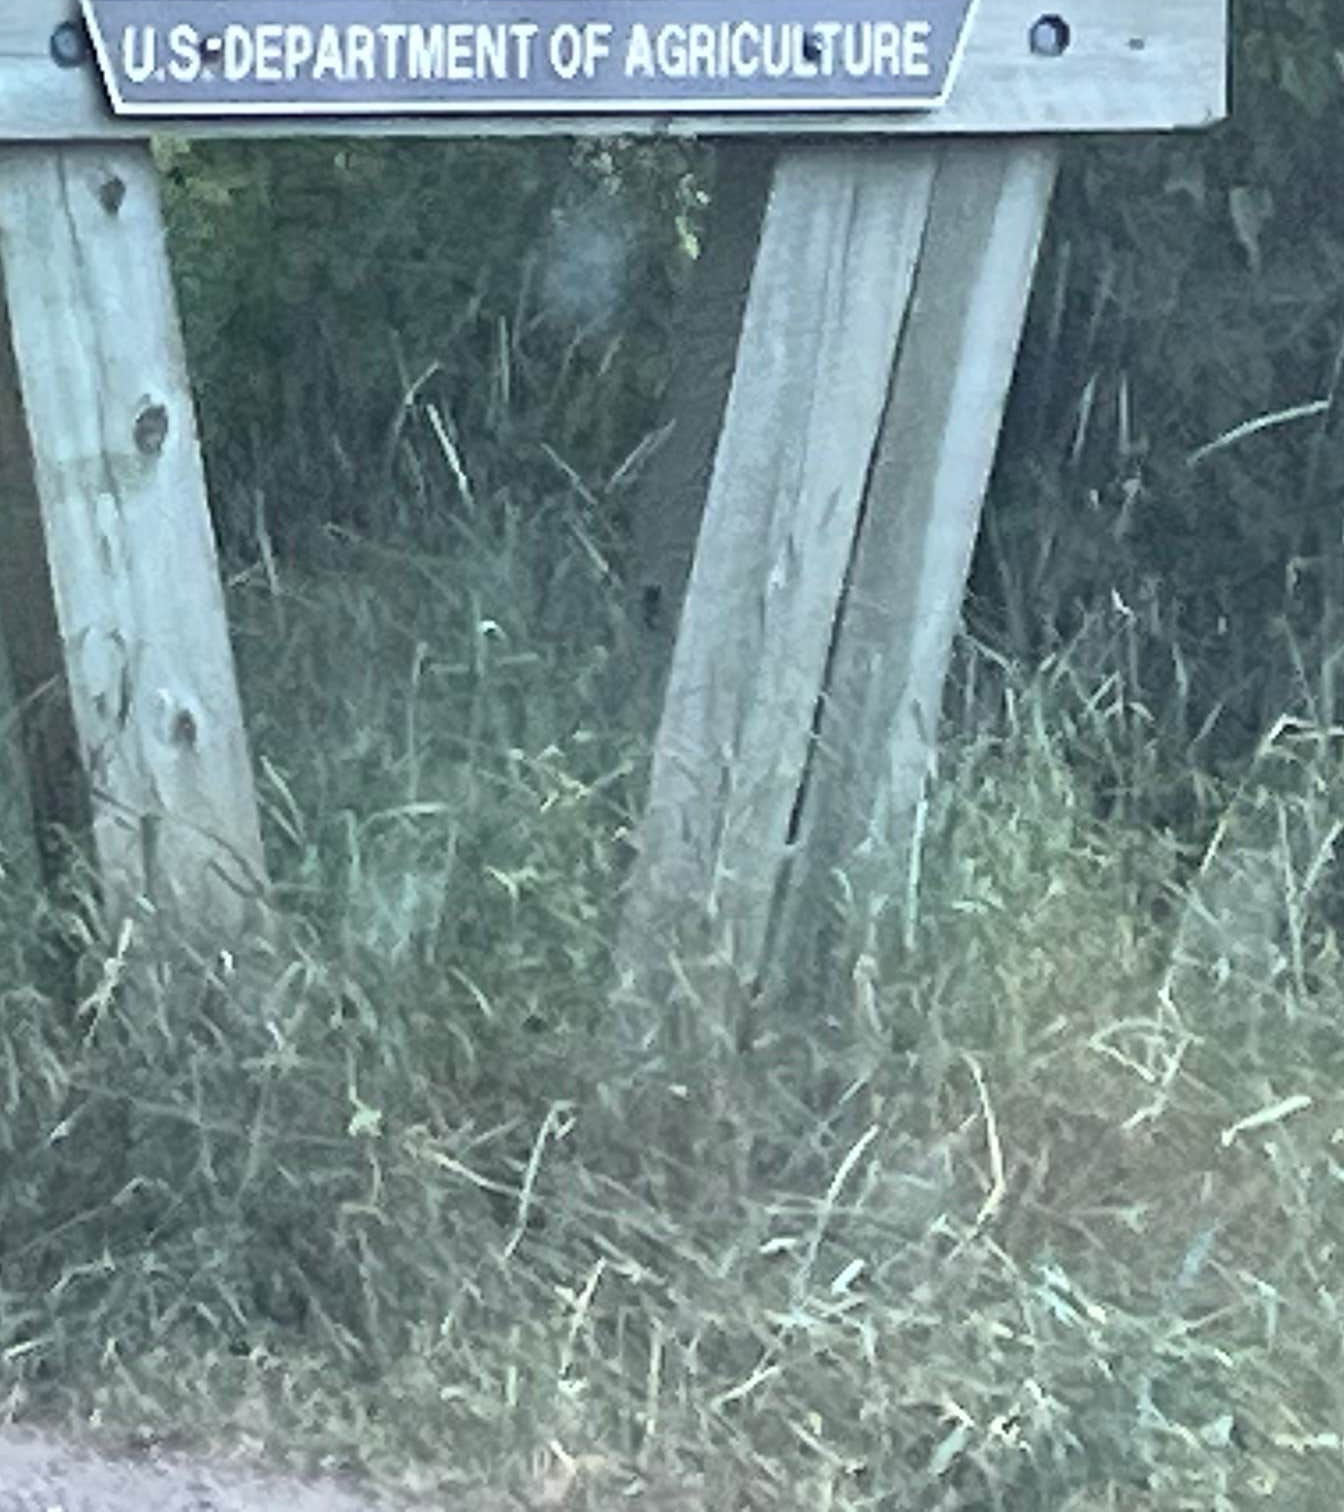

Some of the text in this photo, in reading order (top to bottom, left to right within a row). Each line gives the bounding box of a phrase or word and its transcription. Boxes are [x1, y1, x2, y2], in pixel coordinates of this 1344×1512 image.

[223, 23, 538, 80] DEPARTMENT
[549, 23, 614, 78] OF
[622, 21, 930, 77] AGRICULTURE
